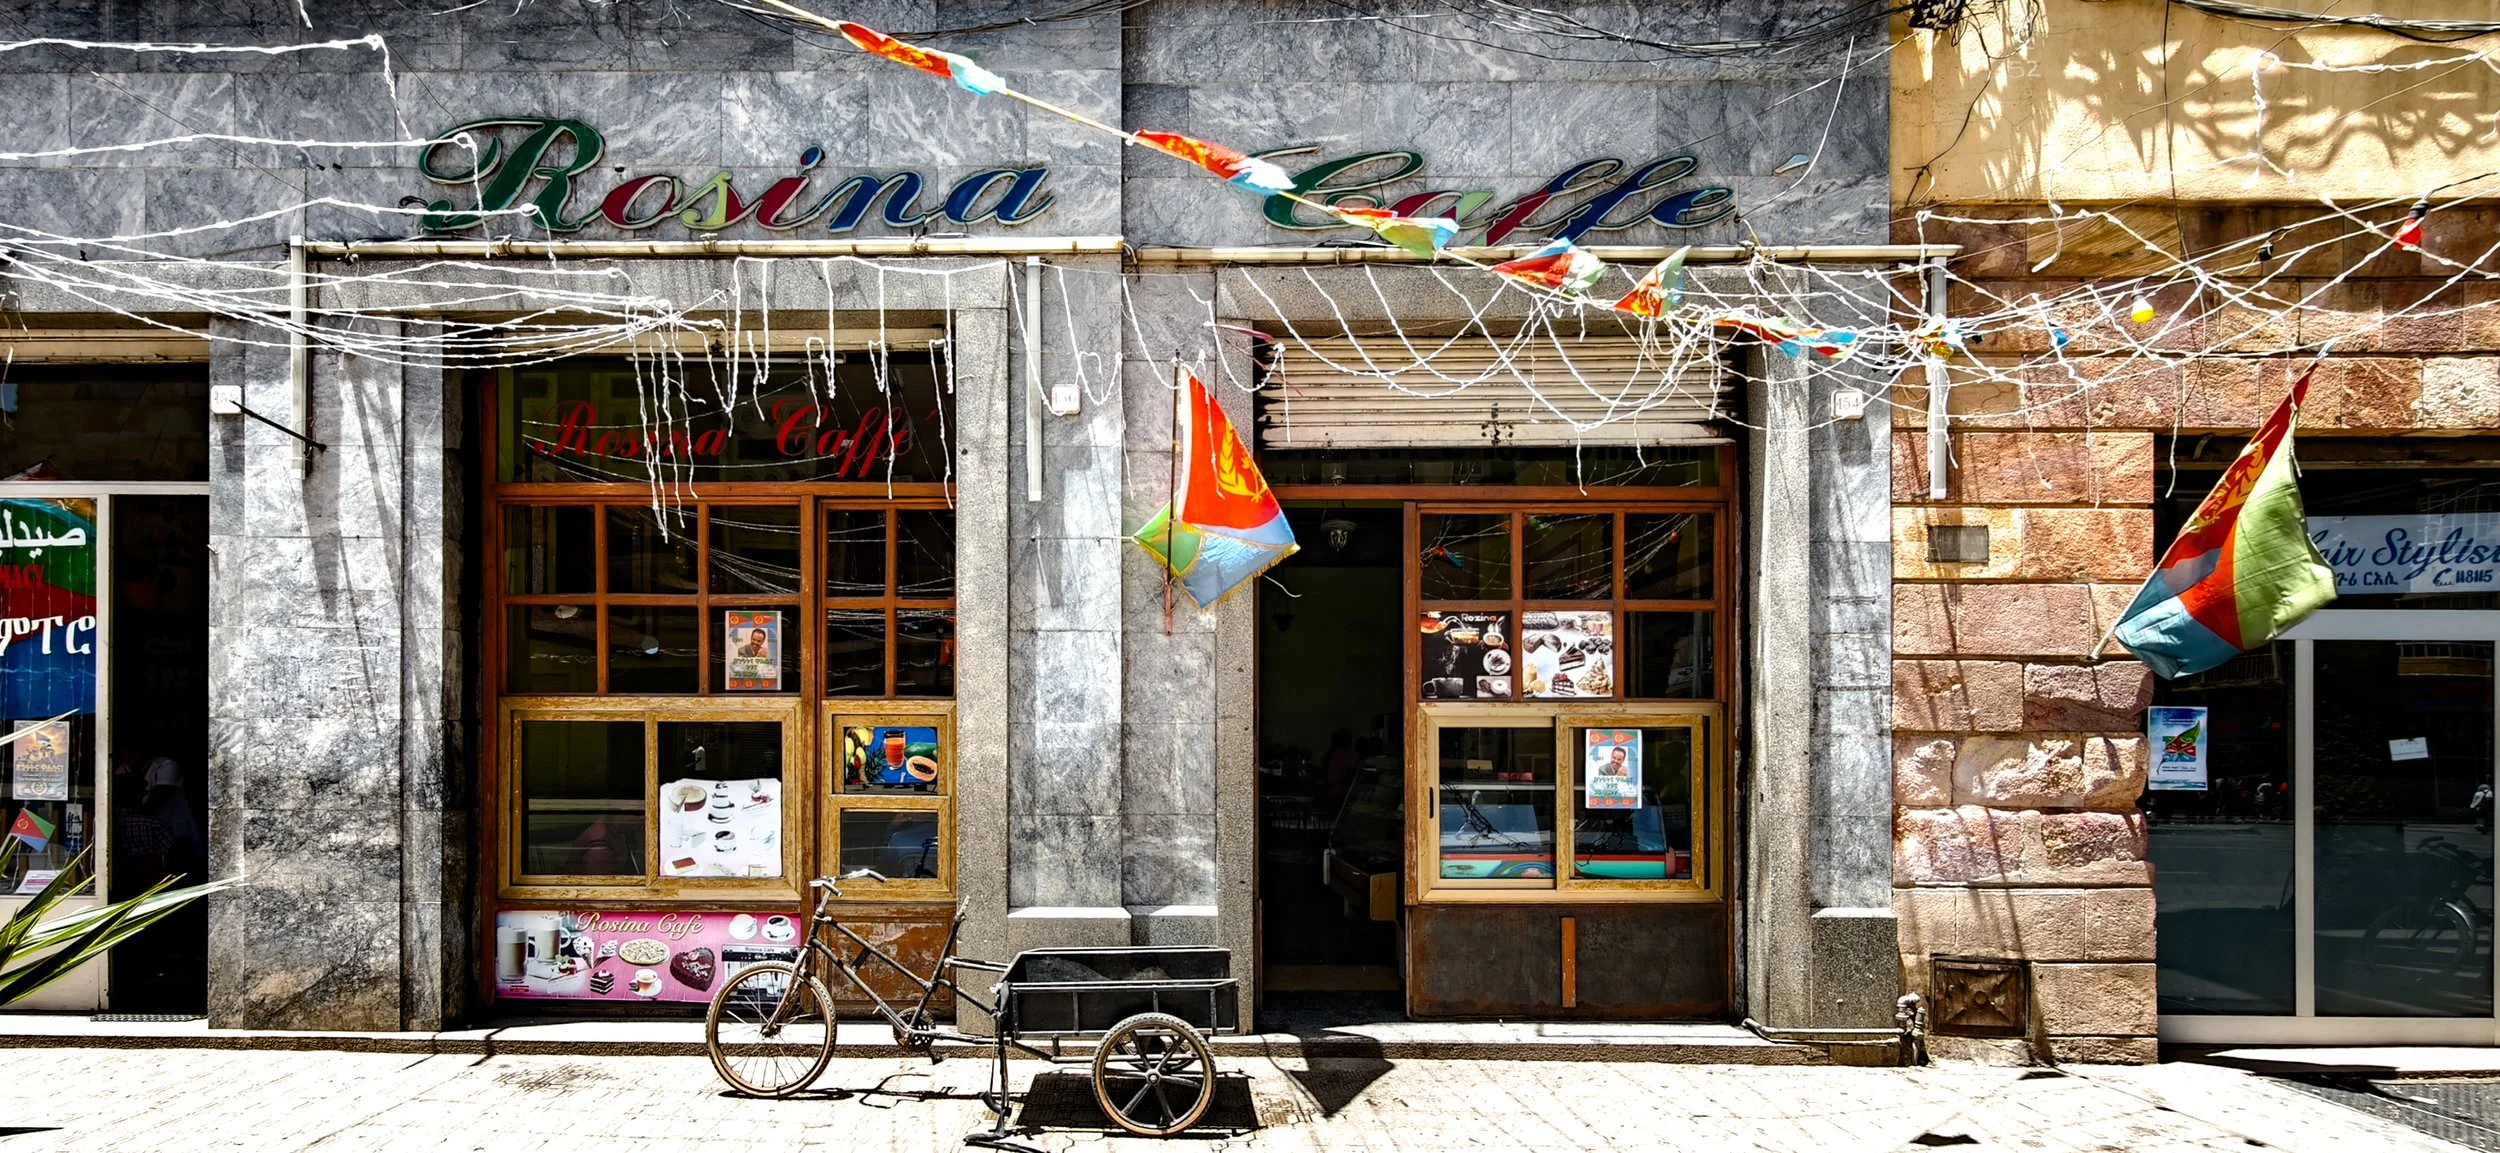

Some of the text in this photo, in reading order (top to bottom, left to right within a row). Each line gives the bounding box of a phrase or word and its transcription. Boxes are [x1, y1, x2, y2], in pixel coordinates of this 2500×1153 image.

[418, 116, 1056, 231] Rosina
[0, 508, 87, 559] صيدل
[2455, 569, 2494, 583] 118115
[1461, 612, 1498, 622] Rozina
[575, 911, 704, 940] Rosina Cafe
